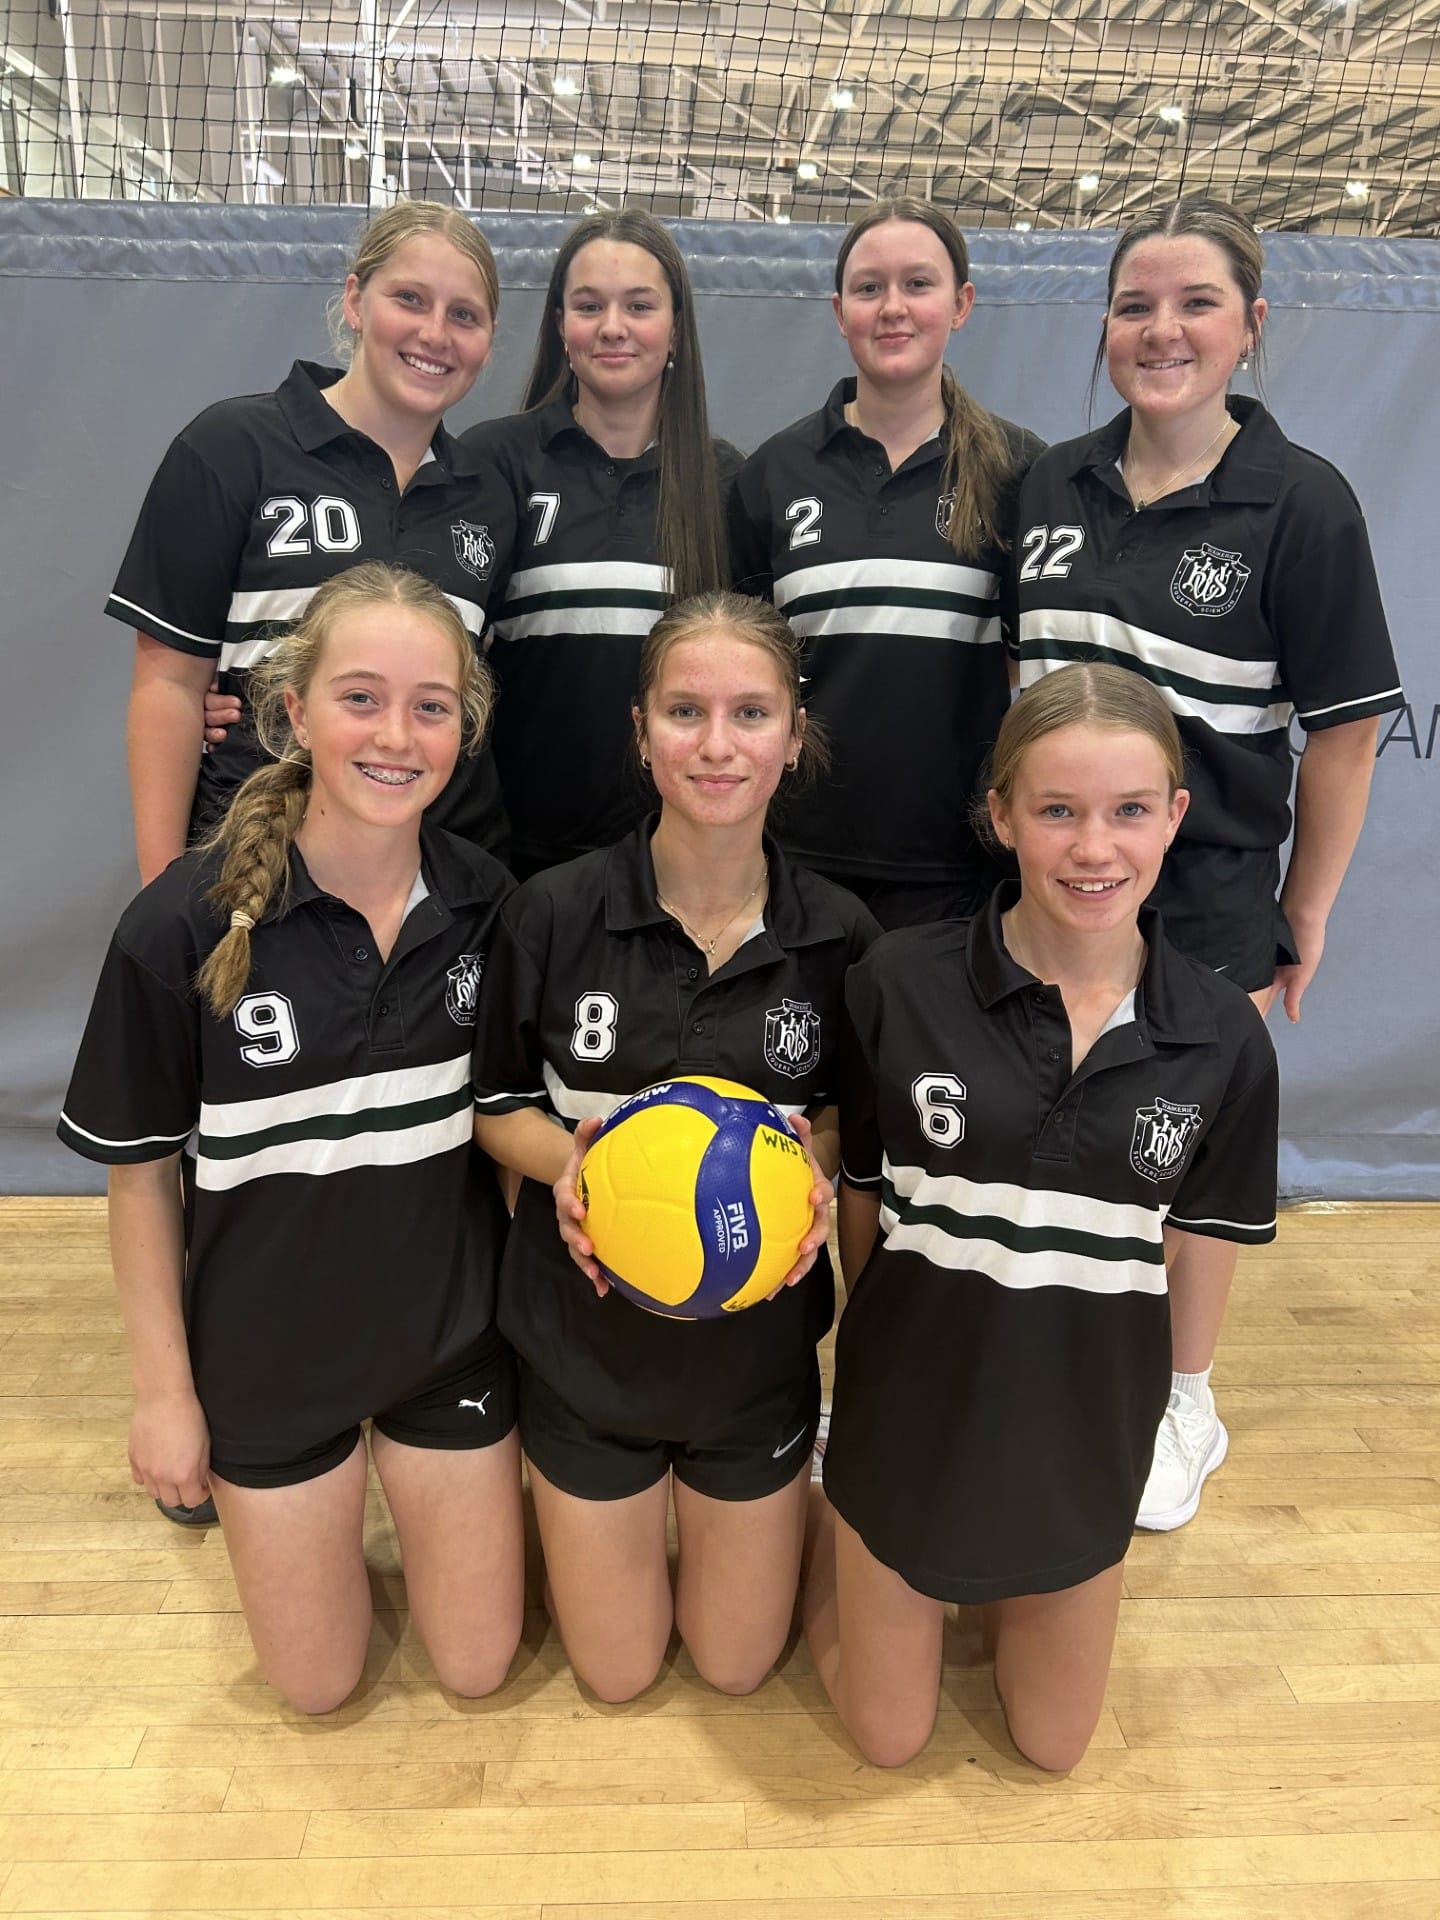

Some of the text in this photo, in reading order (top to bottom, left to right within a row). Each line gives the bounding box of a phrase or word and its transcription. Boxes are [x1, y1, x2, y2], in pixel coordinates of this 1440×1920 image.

[261, 495, 362, 557] 20
[528, 492, 561, 546] 7
[785, 496, 824, 550] 2
[1020, 524, 1086, 583] 22
[233, 991, 300, 1068] 9
[569, 991, 620, 1062] 8
[911, 1072, 967, 1149] 6
[761, 1129, 798, 1156] WHS
[712, 1208, 726, 1254] APPROVED
[727, 1201, 749, 1250] FIVB
